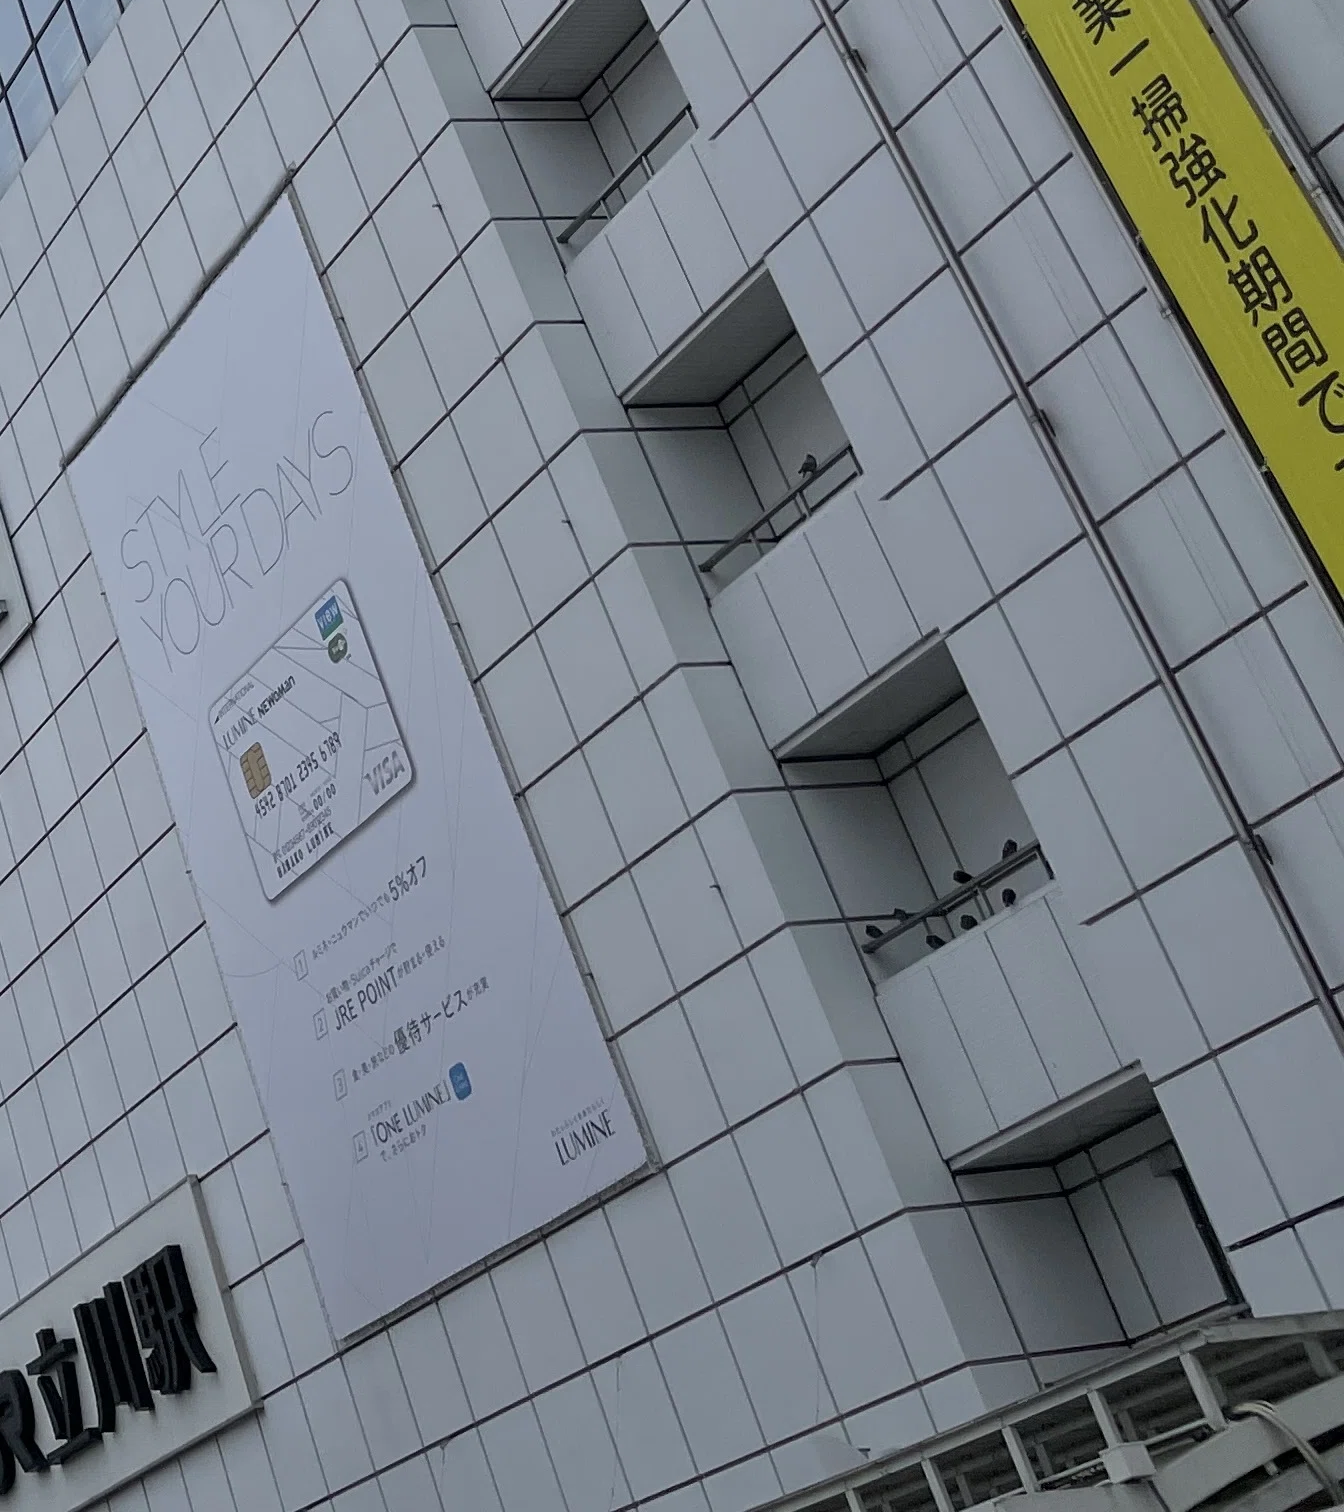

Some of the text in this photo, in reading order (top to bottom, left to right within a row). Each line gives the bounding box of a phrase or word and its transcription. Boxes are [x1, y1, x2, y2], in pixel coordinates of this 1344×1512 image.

[120, 426, 242, 604] STYLE
[139, 410, 354, 674] YOUR DAYS
[363, 750, 406, 796] VISA
[335, 998, 358, 1031] JRE
[554, 1108, 616, 1166] LUMINE
